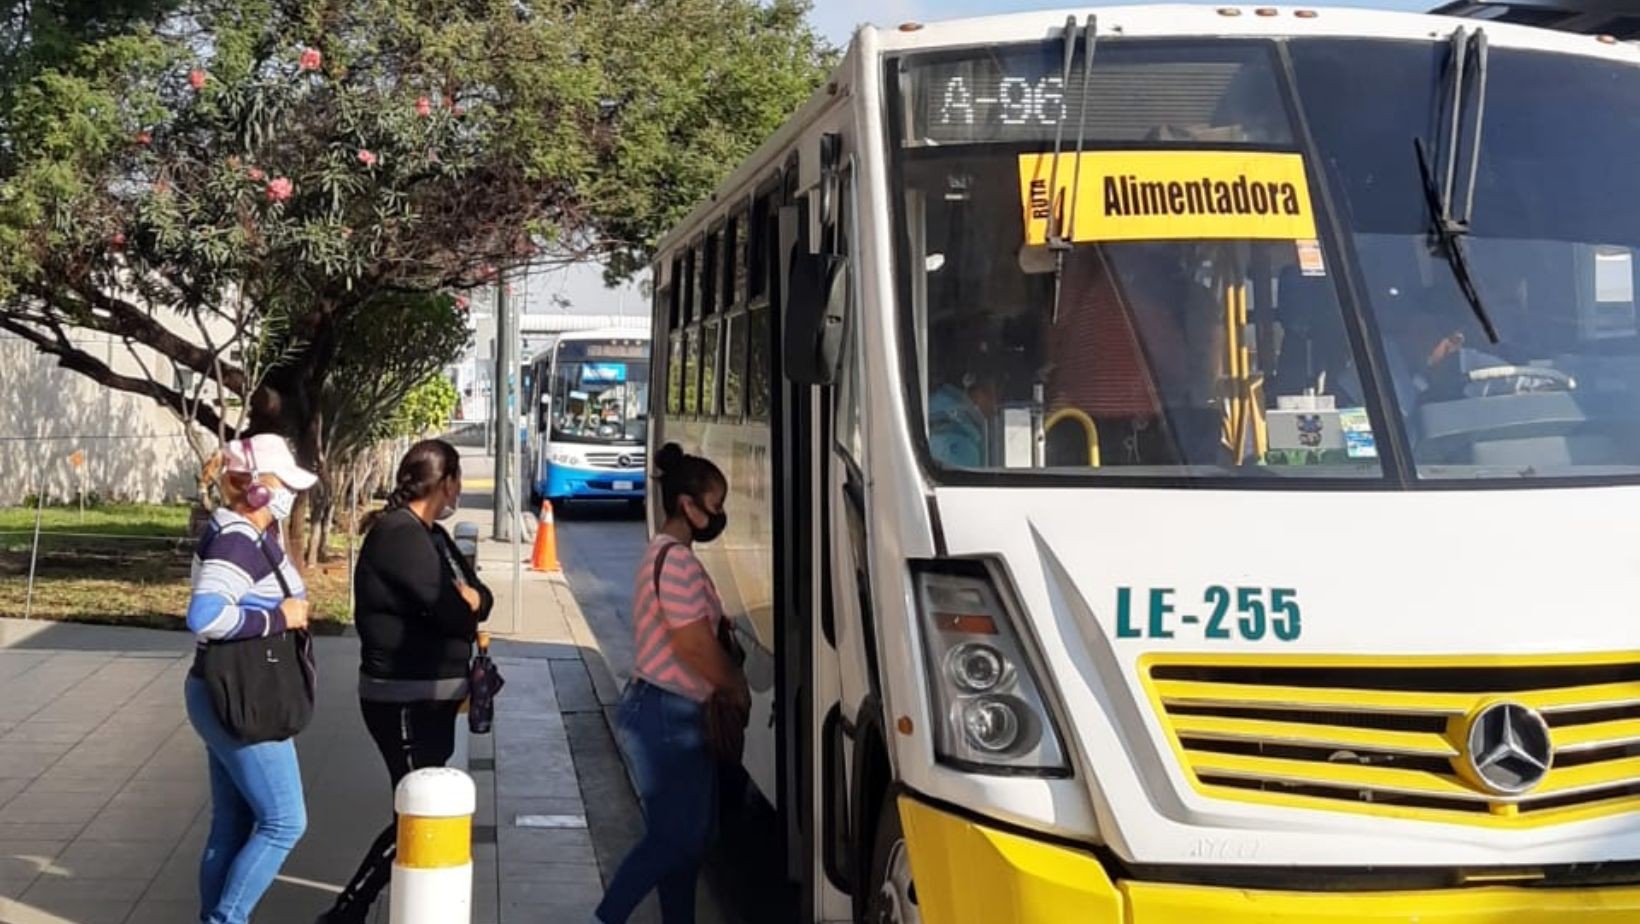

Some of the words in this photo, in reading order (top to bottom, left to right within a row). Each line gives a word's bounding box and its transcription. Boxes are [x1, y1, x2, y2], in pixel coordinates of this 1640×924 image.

[941, 77, 1067, 124] A-96
[1030, 179, 1050, 219] RUTA
[1103, 175, 1300, 217] Alimentadora
[1116, 585, 1302, 641] LE-255
